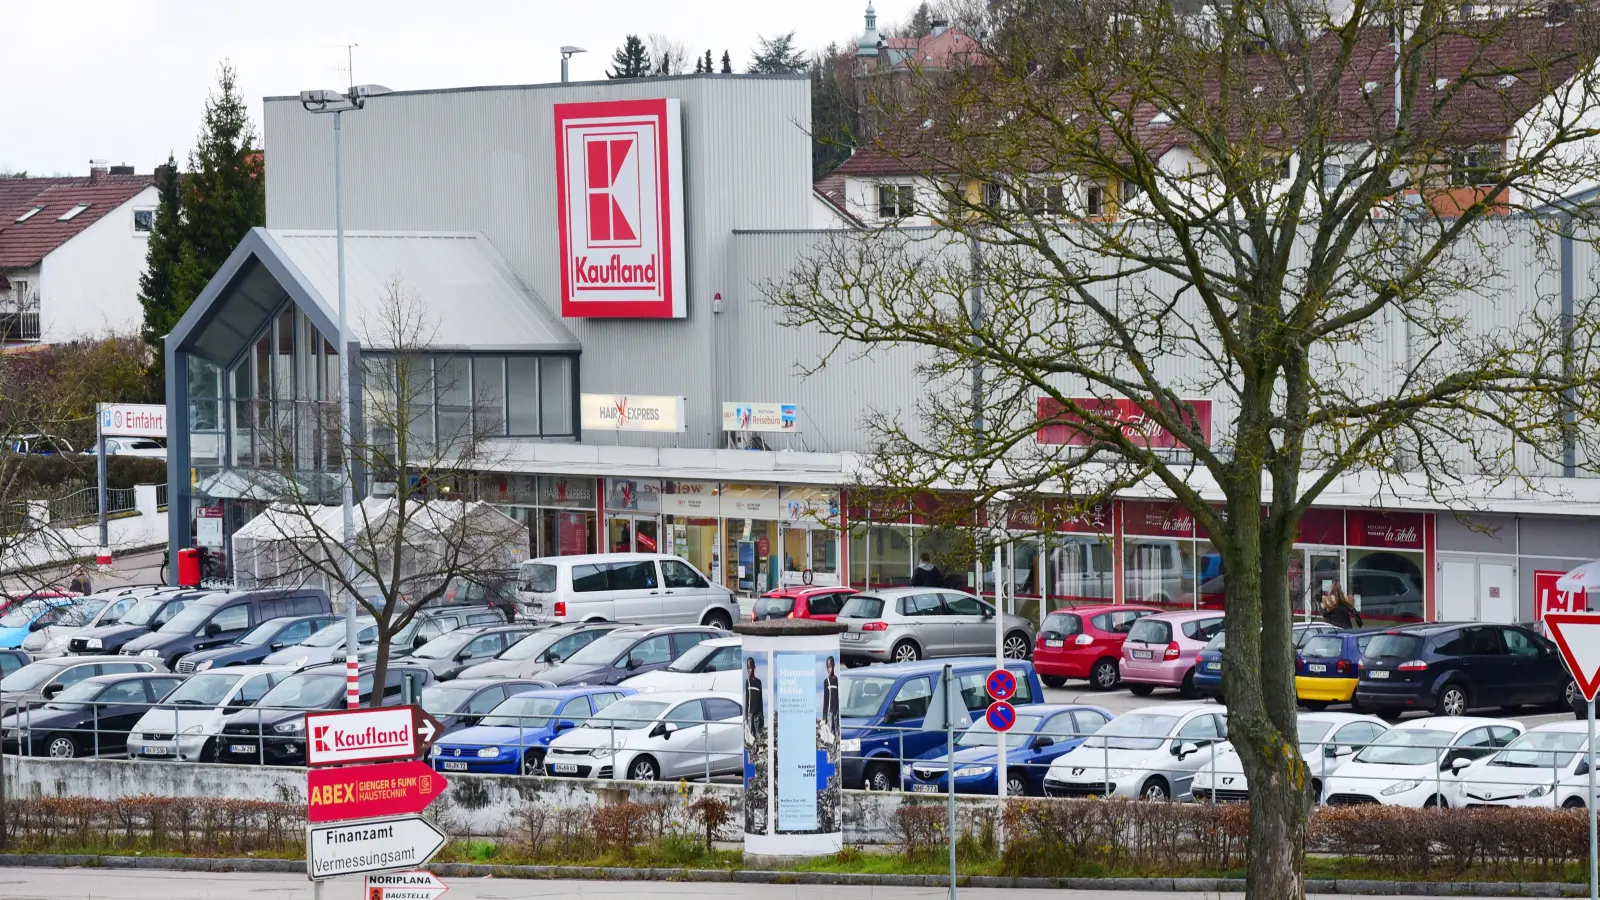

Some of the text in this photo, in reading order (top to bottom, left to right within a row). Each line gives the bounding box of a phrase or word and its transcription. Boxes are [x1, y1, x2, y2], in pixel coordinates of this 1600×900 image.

[575, 253, 656, 283] Kaufland
[126, 411, 163, 430] Einfahrt
[600, 406, 660, 421] HAIR EXPRESS
[752, 415, 781, 425] Reisebüro
[1171, 516, 1192, 532] stella
[1384, 525, 1418, 543] la stella
[779, 668, 814, 677] Himmel
[334, 724, 409, 748] Kaufland
[359, 777, 417, 792] GIENGER & FUNK
[310, 783, 355, 806] ABEX
[359, 788, 407, 801] HAUSTECHNIK
[326, 825, 394, 845] Finanzamt
[314, 846, 416, 873] Vermessungsamt
[369, 876, 432, 885] NORIPLANA
[385, 892, 431, 900] BAUSTELLE
